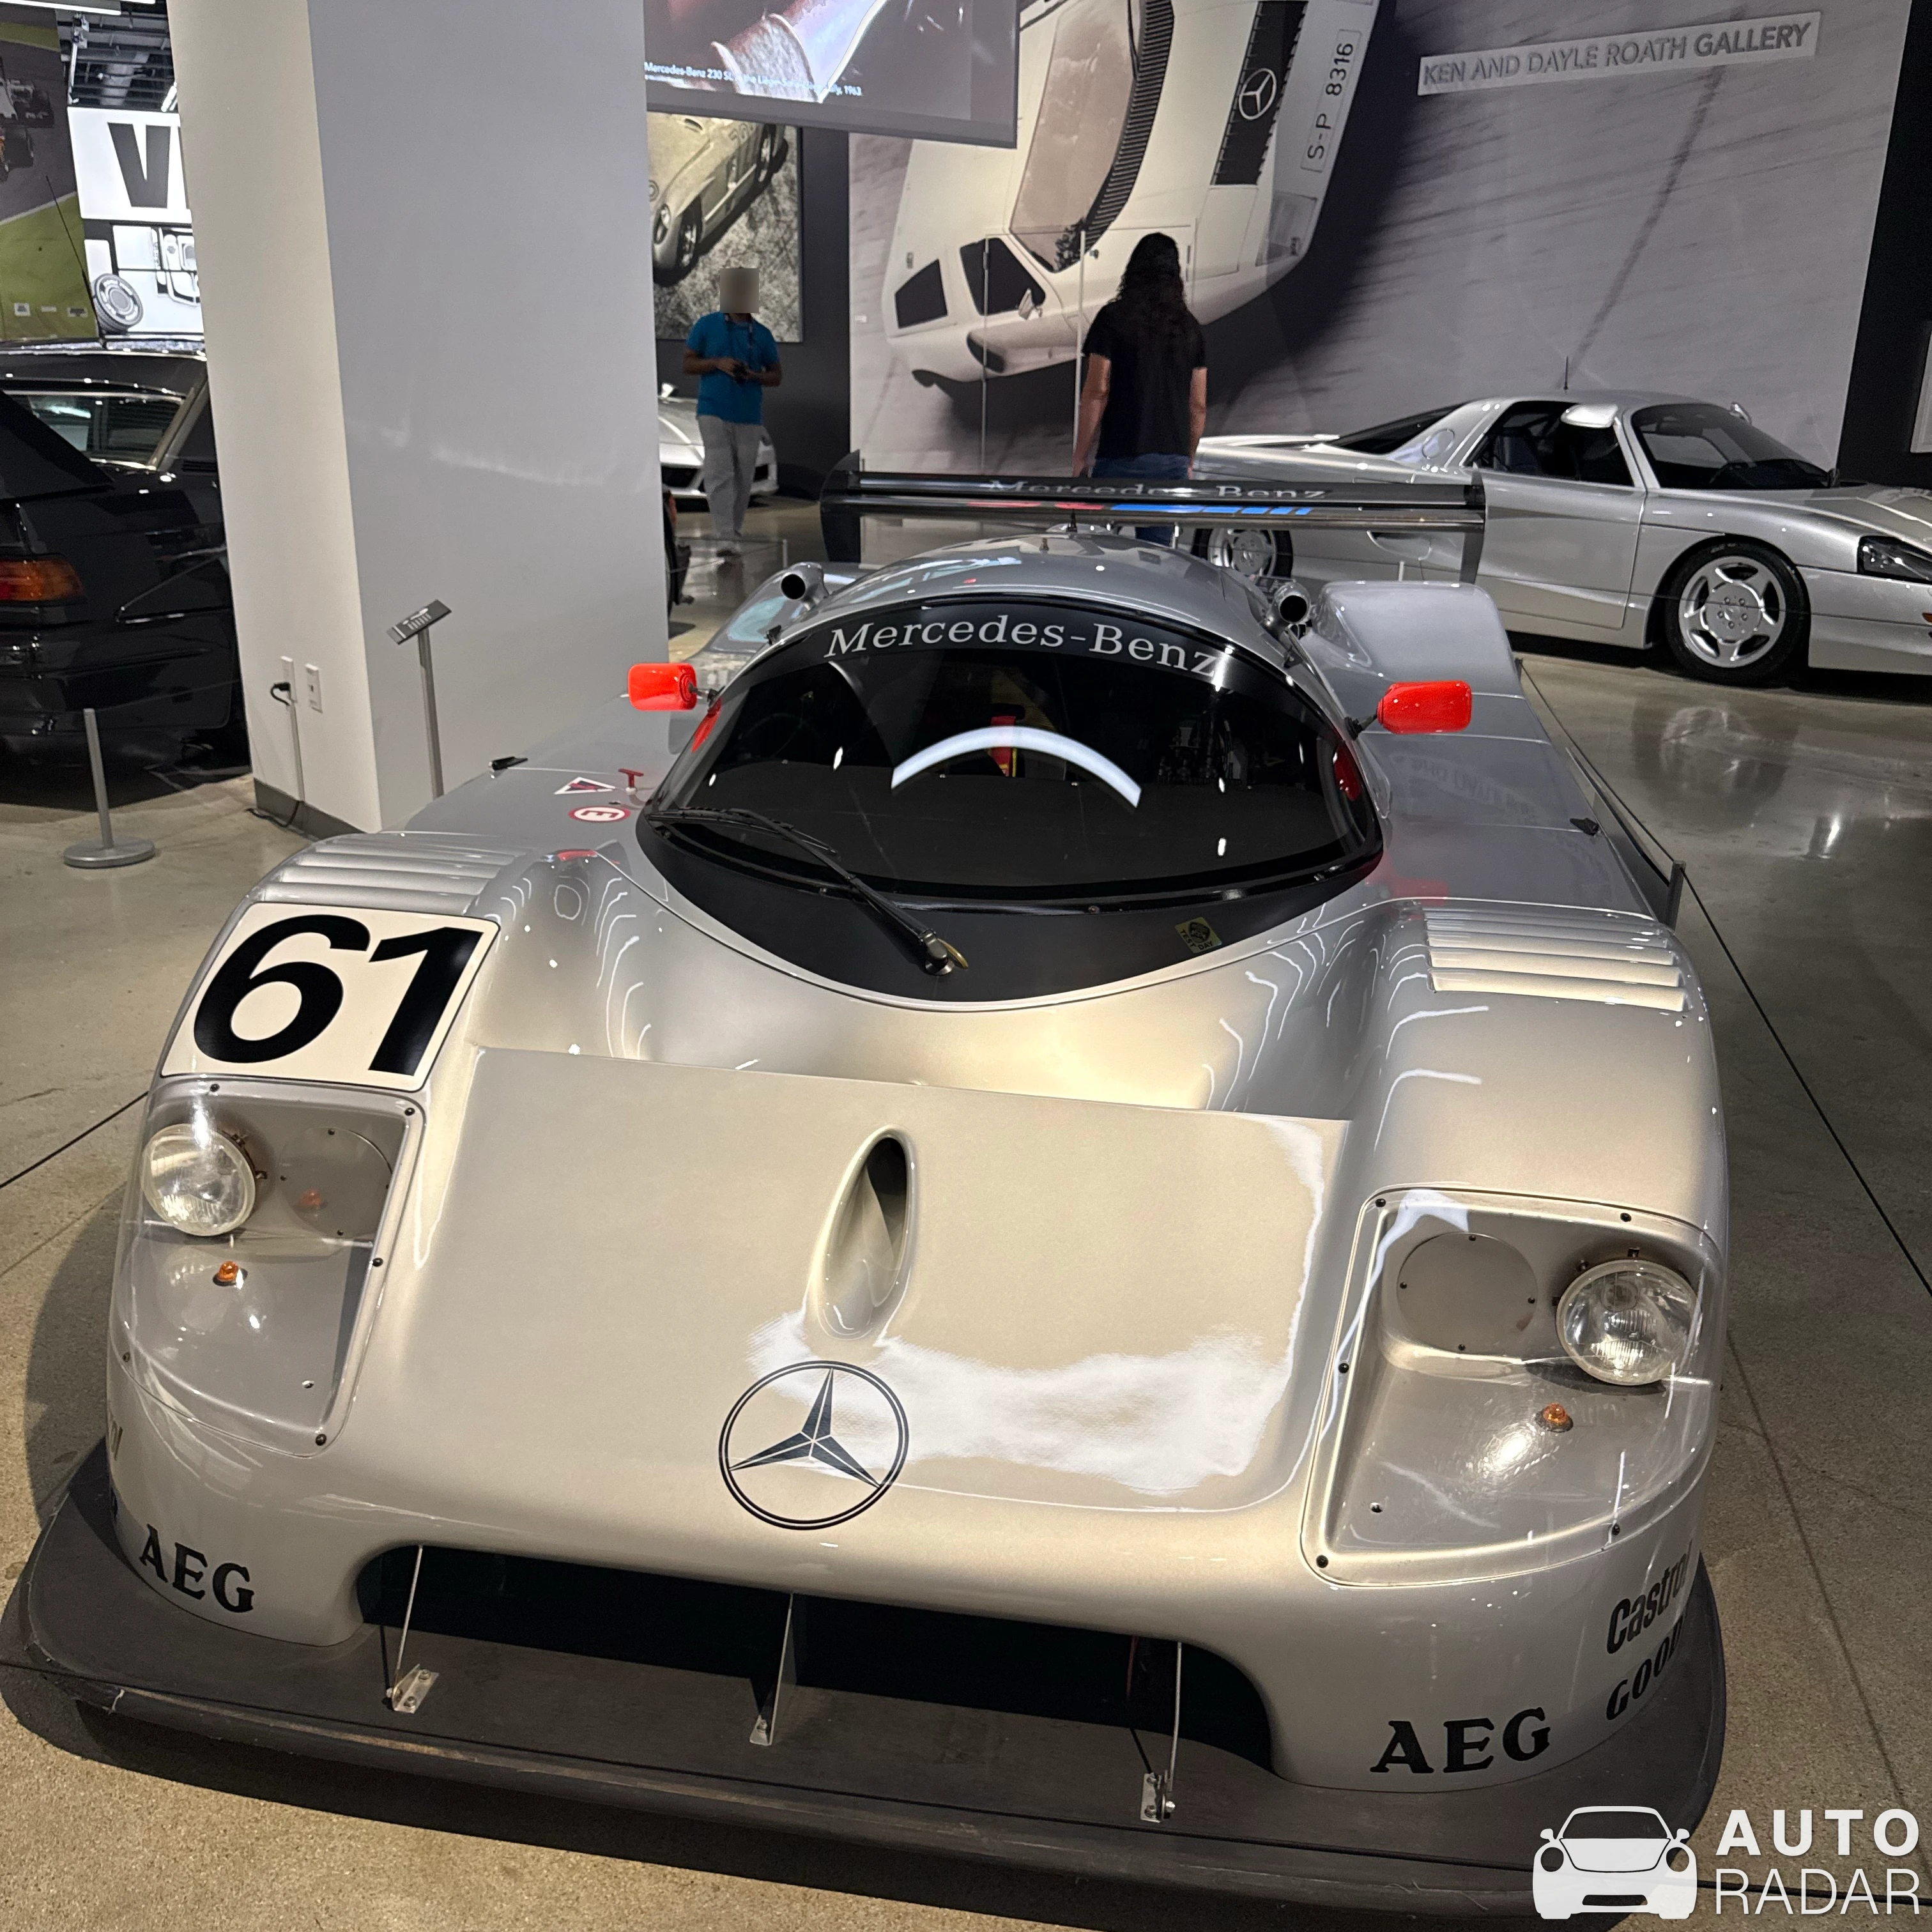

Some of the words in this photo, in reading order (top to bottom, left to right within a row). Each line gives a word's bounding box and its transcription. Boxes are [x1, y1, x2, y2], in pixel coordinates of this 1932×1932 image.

[1325, 43, 1354, 96] 8316
[1423, 59, 1466, 86] KEN
[1471, 55, 1520, 80] AND
[1527, 45, 1599, 74] DAYLE
[1606, 35, 1687, 67] ROATH
[1693, 21, 1811, 57] GALLERY
[824, 615, 1216, 678] Mercedes-Benz
[1180, 929, 1197, 948] TEST
[1197, 940, 1213, 951] DAY
[194, 914, 484, 1076] 61
[139, 1523, 254, 1613] AEG
[1369, 1706, 1551, 1774] AEG
